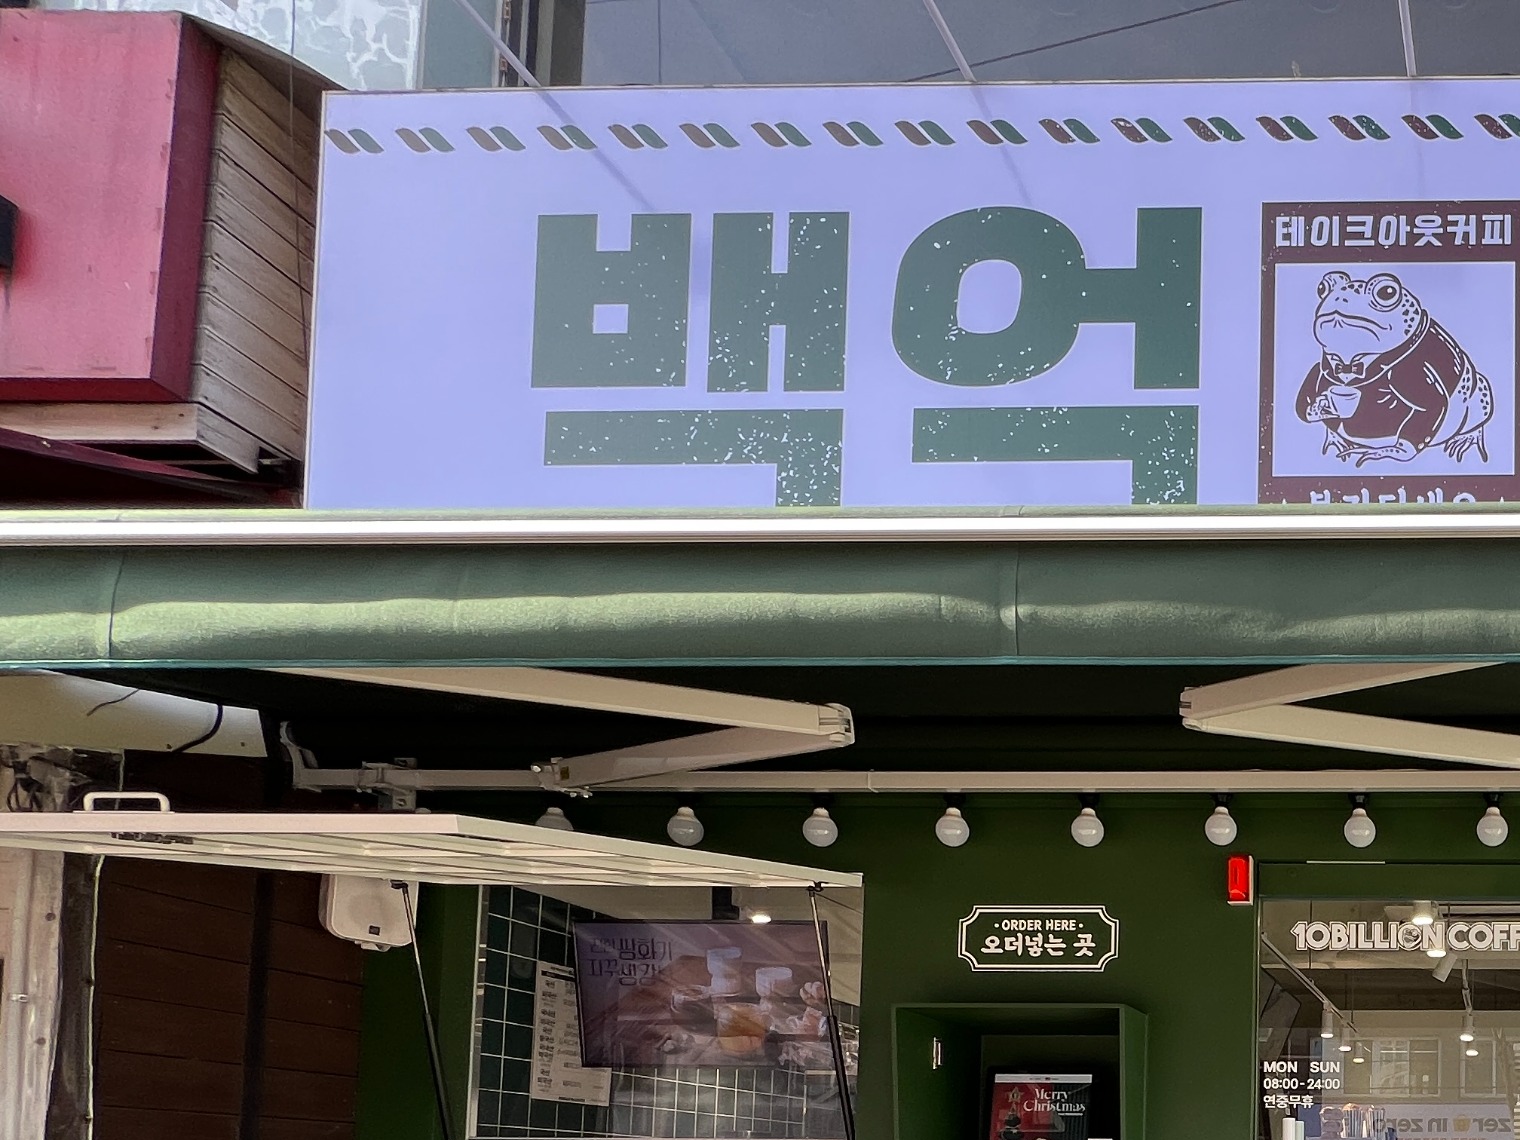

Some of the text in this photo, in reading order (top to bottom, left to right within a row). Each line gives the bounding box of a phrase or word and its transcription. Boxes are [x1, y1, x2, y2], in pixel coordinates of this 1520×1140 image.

[1274, 213, 1513, 248] 테이크아웃커피
[531, 205, 1203, 507] 백억
[1001, 919, 1077, 931] ORDER HERE
[1290, 920, 1446, 950] 10BILLION
[980, 932, 1097, 957] 오더넣는 곳
[1263, 1061, 1341, 1073] MON SUN
[1034, 1088, 1068, 1102] Merry
[1263, 1094, 1315, 1109] 연중무휴
[1023, 1099, 1086, 1112] Christmas
